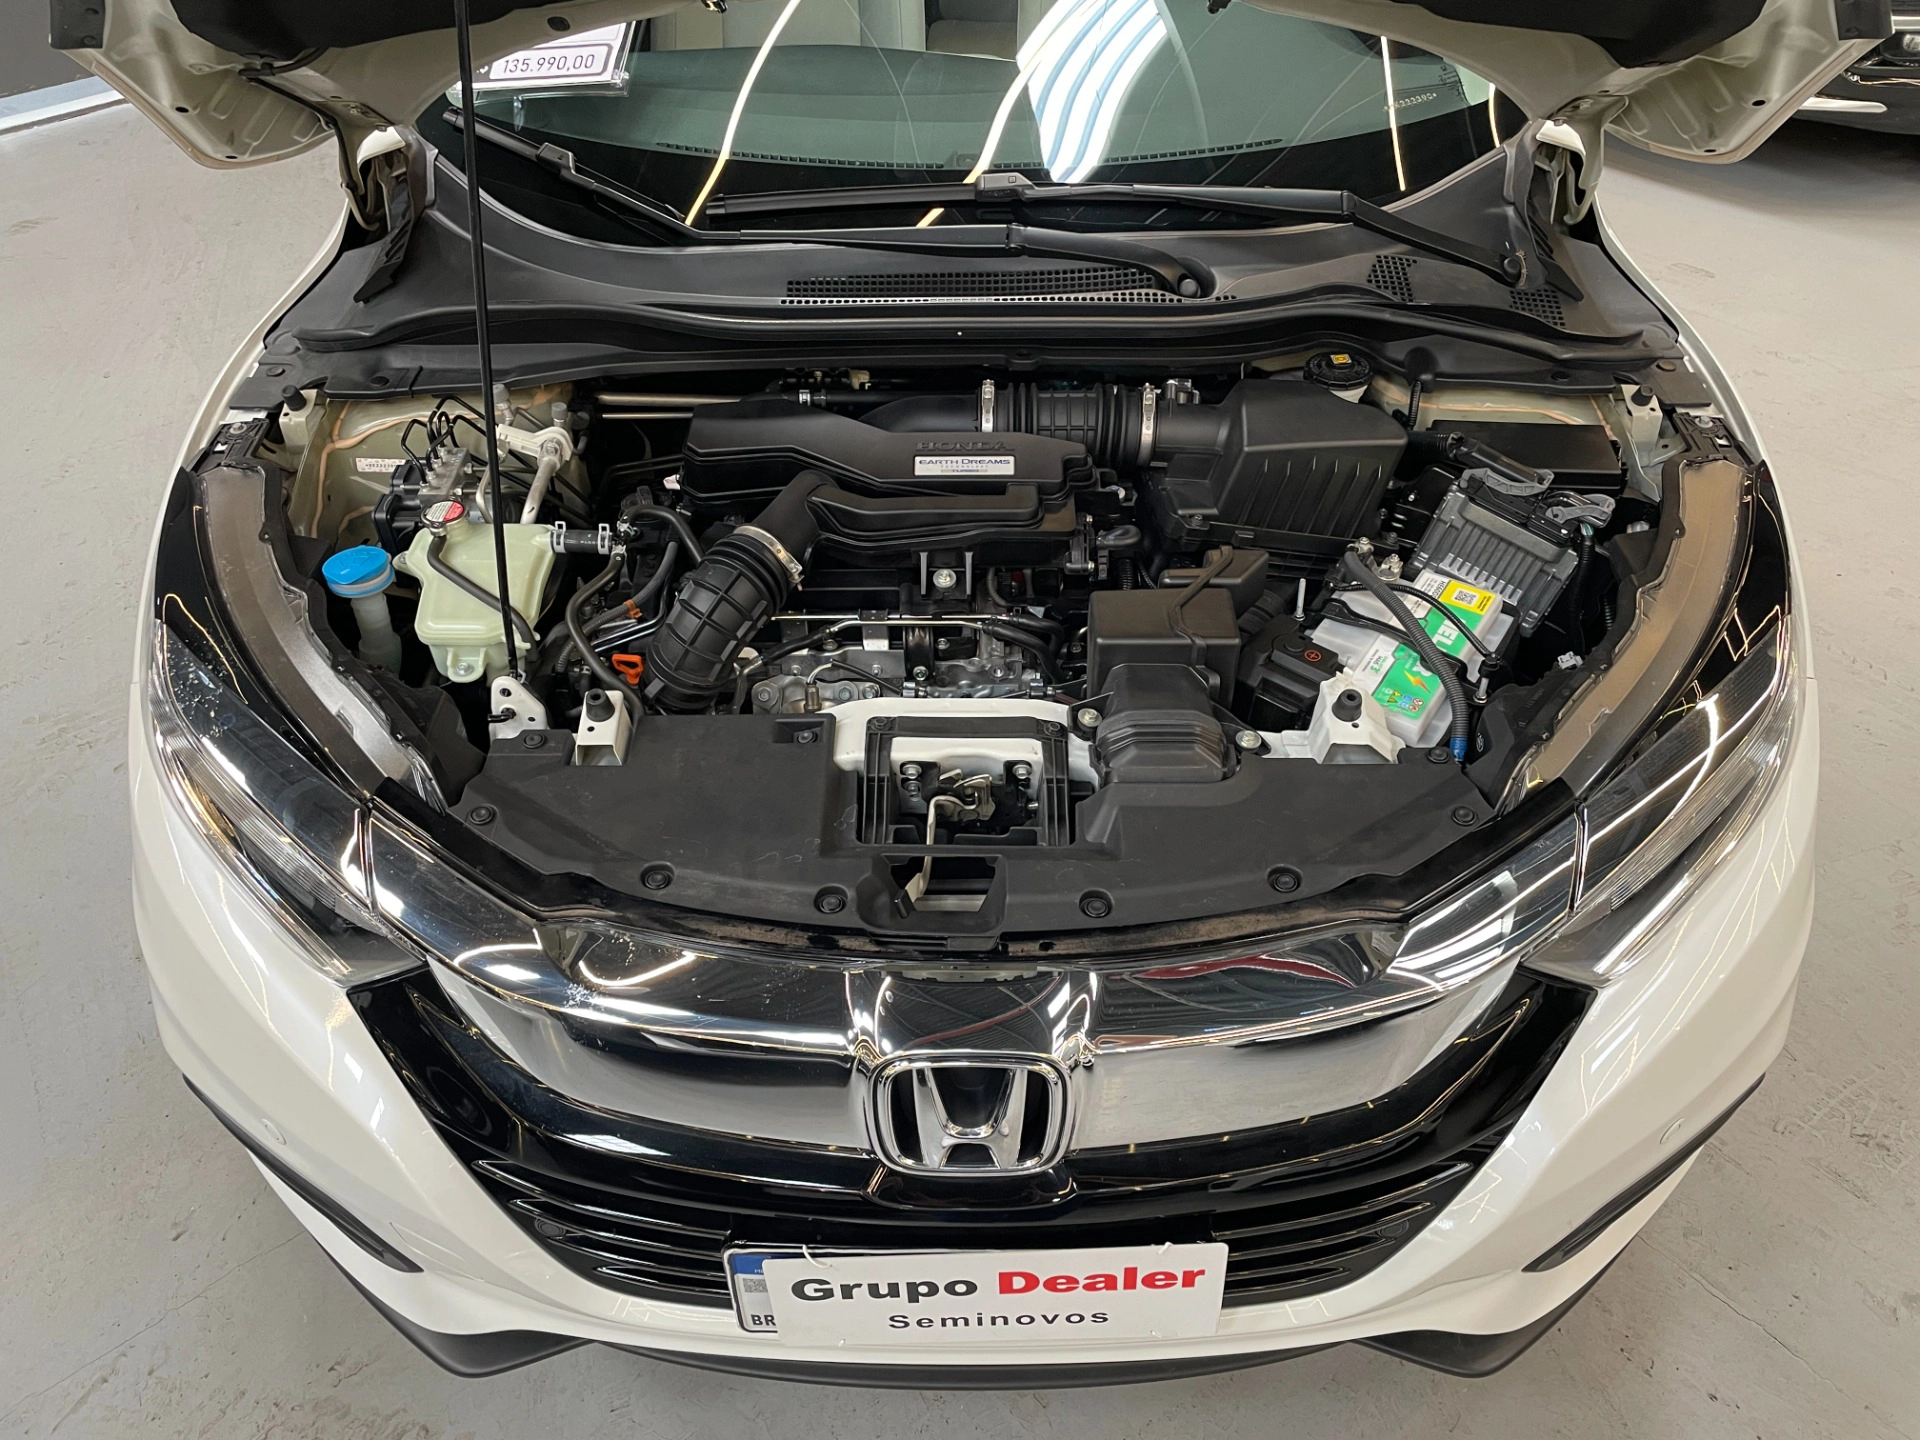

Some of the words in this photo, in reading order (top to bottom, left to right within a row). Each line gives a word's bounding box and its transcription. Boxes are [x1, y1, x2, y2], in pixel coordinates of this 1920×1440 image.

[502, 54, 596, 74] 135.990,00
[915, 441, 1015, 452] HONDA
[791, 1278, 978, 1303] Grupo
[998, 1266, 1206, 1295] Dealer
[750, 1314, 776, 1326] BR
[888, 1311, 1109, 1329] Seminovos
